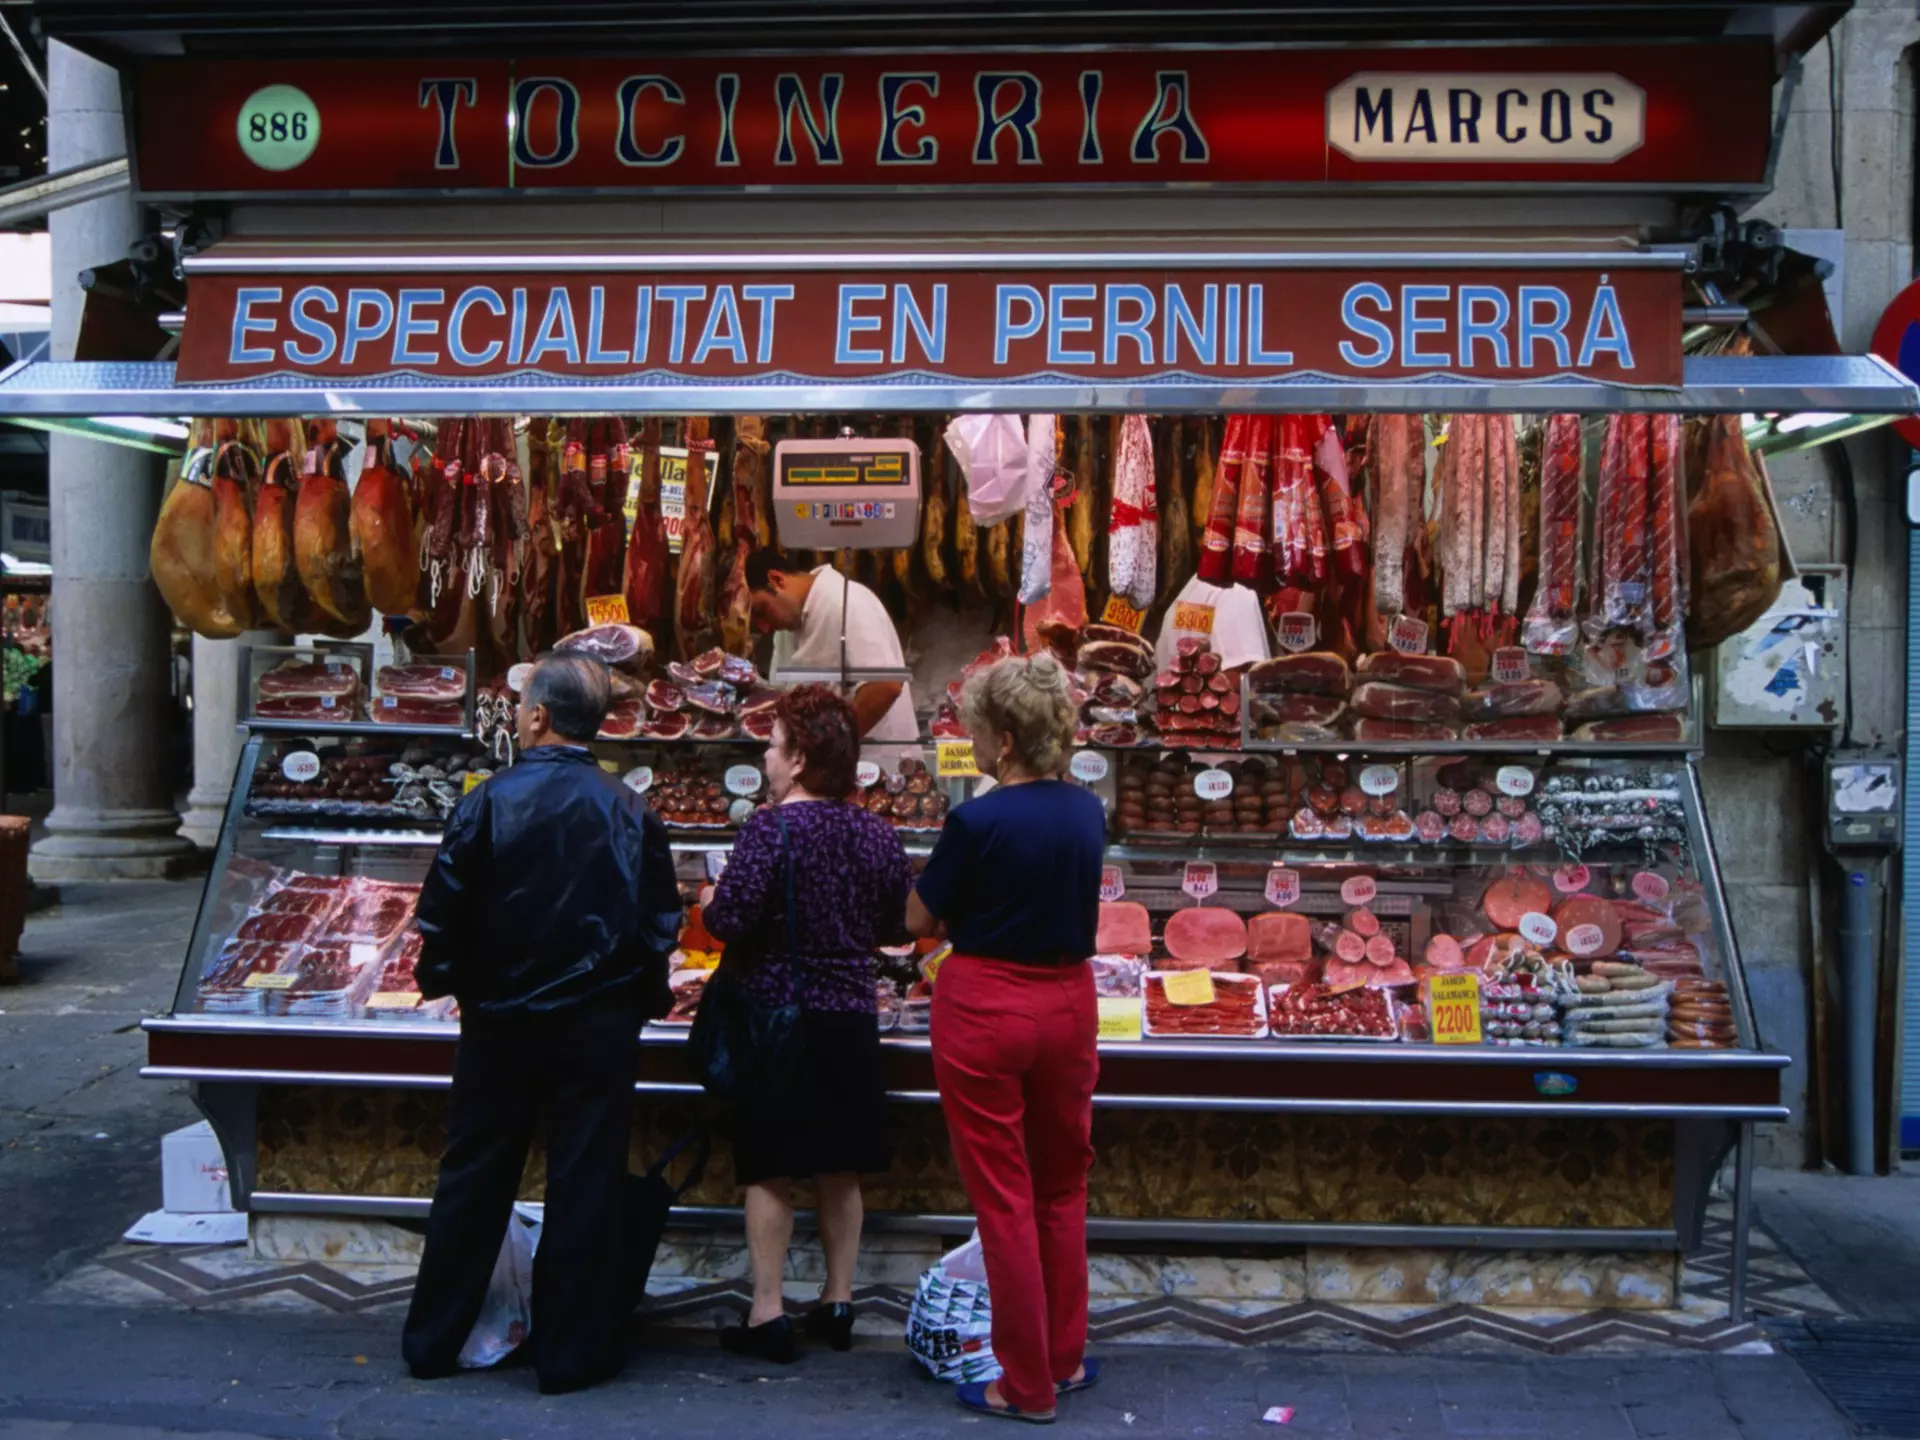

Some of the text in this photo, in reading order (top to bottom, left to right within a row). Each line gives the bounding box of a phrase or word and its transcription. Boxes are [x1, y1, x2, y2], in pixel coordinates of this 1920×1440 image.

[249, 112, 309, 142] 886
[418, 70, 1211, 170] TOCINERIA
[1353, 87, 1616, 145] MARCOS
[228, 283, 795, 366] ESPECIALITAT
[833, 283, 948, 365] EN
[993, 283, 1294, 366] PERNIL
[1435, 1003, 1474, 1035] 2200
